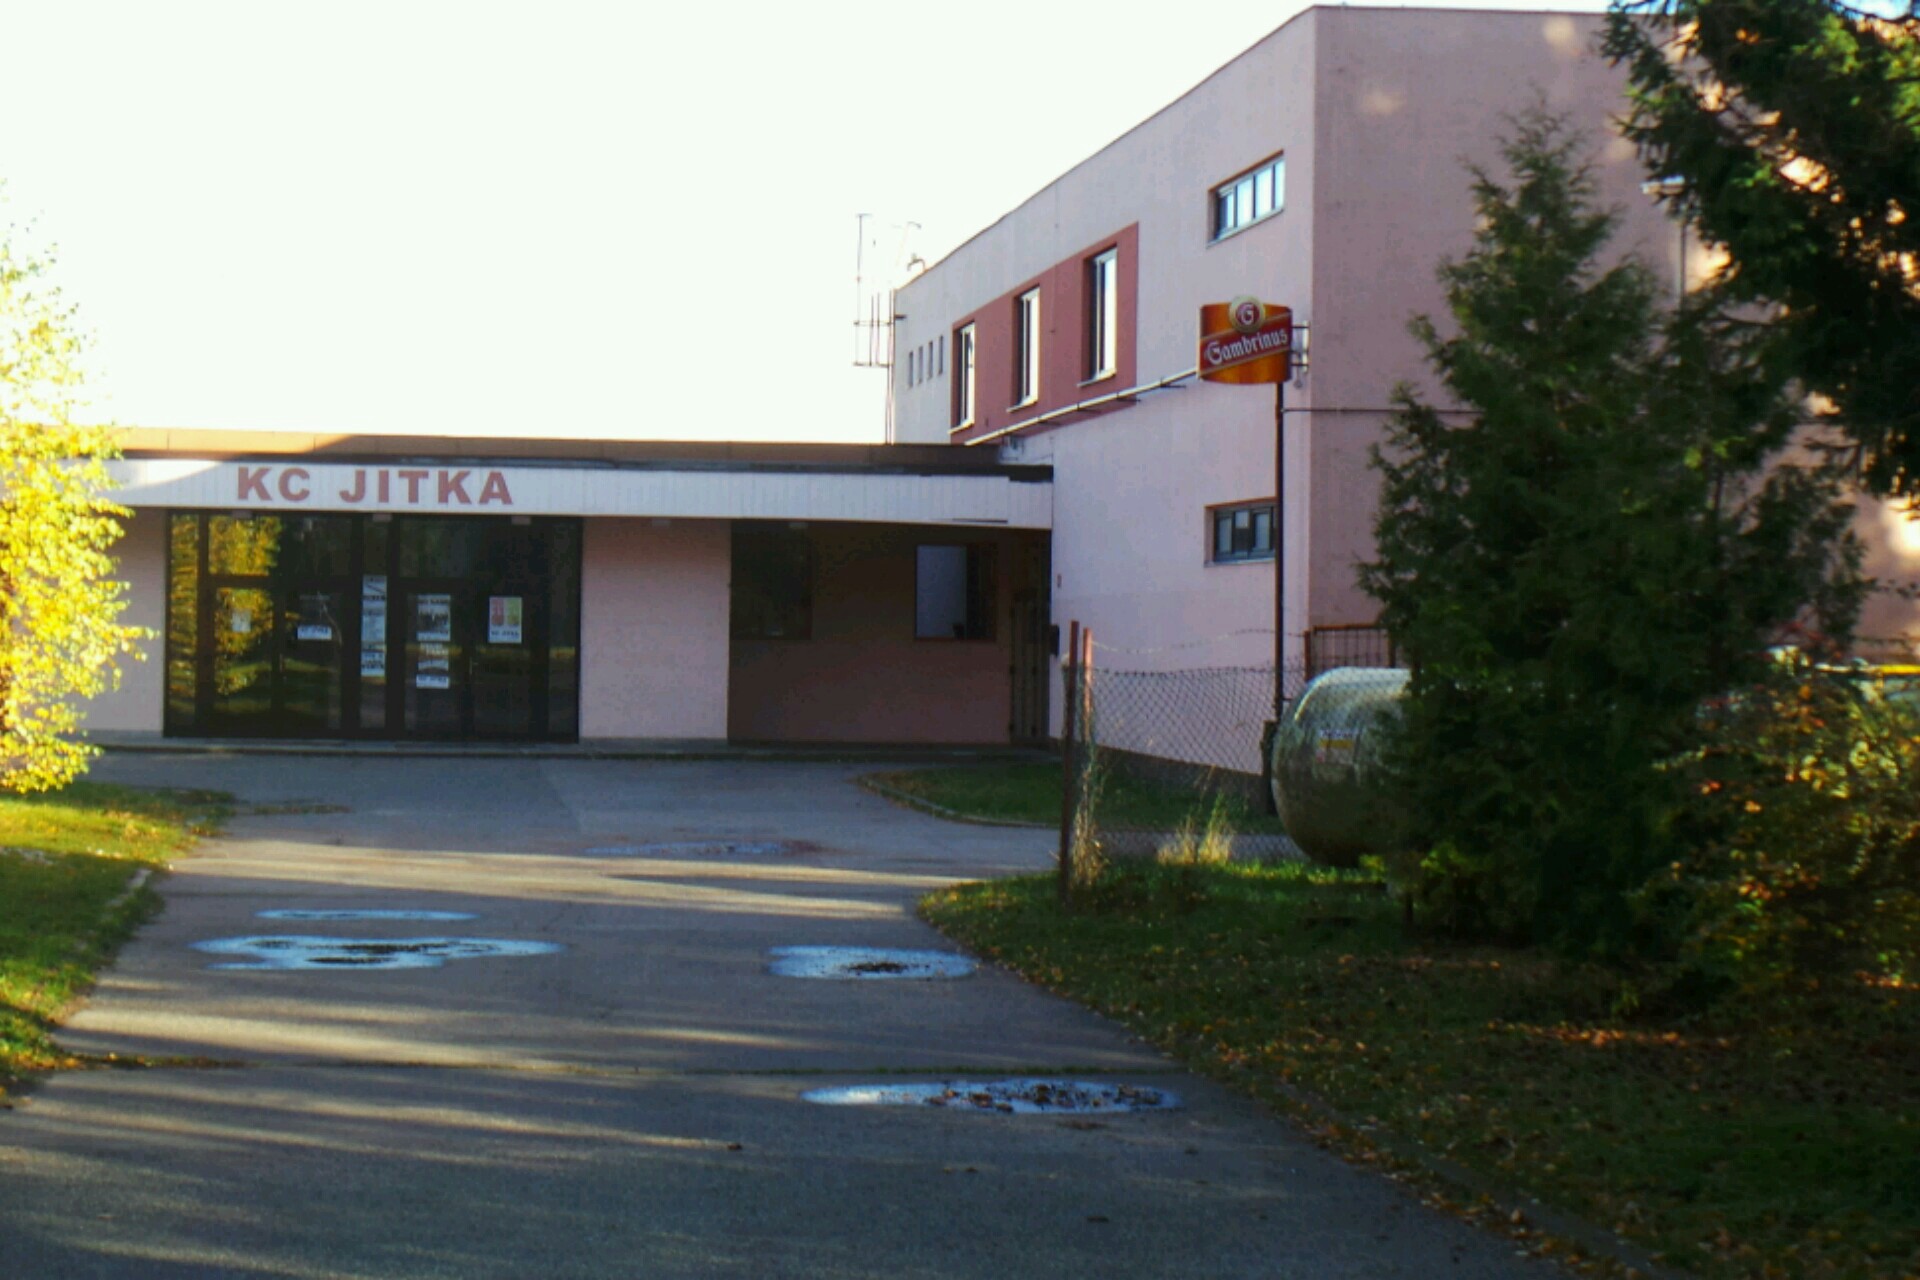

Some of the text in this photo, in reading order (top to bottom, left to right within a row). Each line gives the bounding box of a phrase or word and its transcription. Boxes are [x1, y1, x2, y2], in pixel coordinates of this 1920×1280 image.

[1240, 303, 1255, 325] G
[1204, 328, 1288, 365] Gambrinus
[237, 466, 514, 505] KC JITKA
